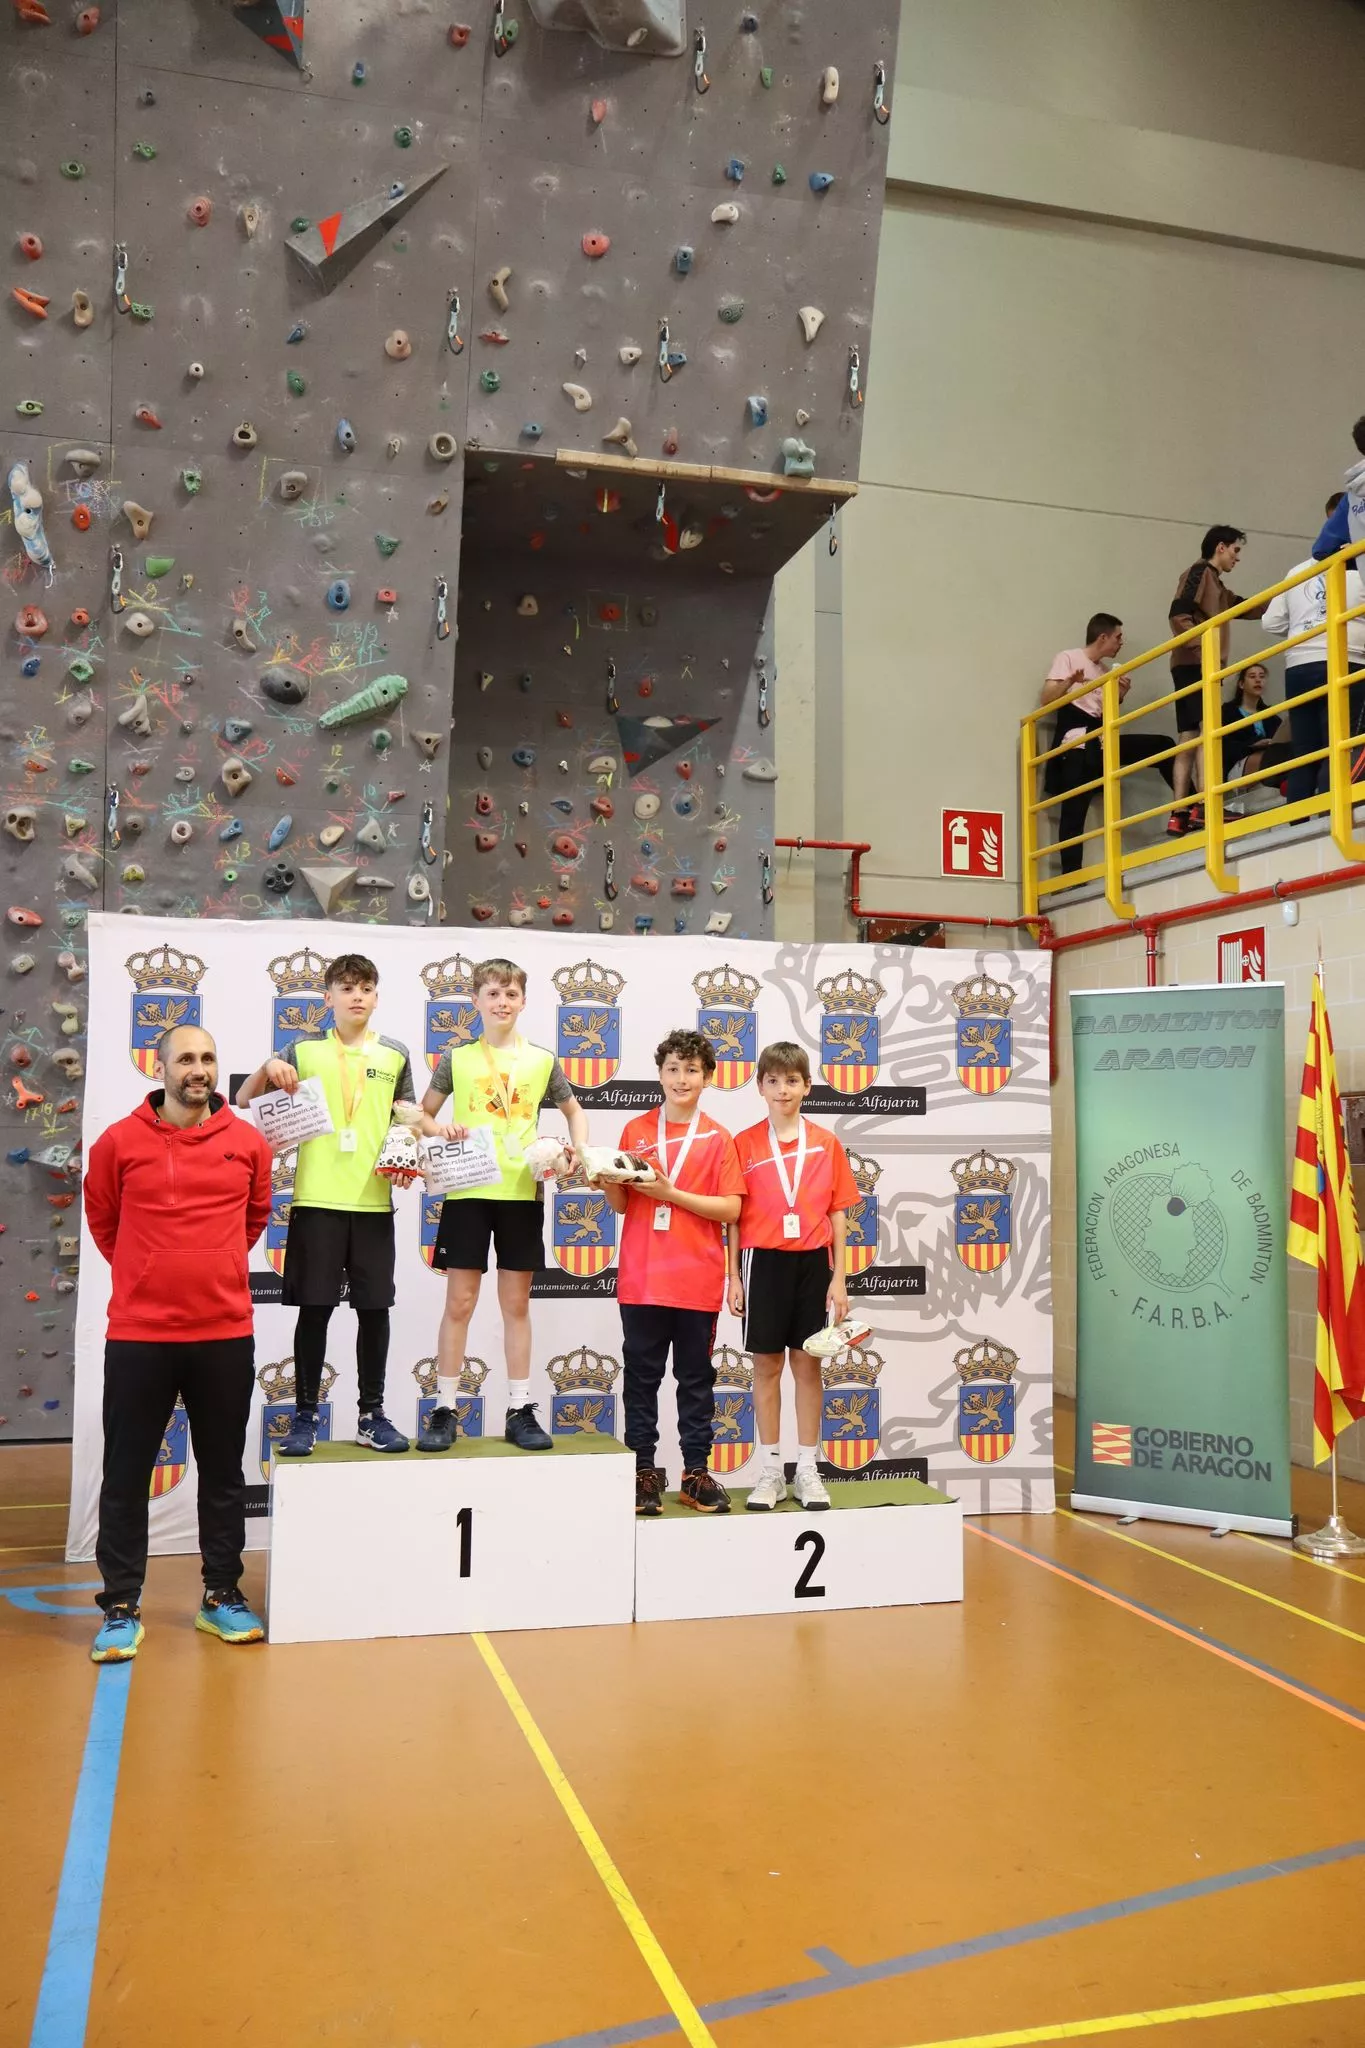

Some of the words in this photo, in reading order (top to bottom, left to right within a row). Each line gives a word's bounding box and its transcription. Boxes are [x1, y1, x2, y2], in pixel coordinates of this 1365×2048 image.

[1073, 1008, 1284, 1036] BADMINTON
[1093, 1045, 1256, 1071] ARAGON
[258, 1094, 303, 1120] RSL
[427, 1140, 474, 1161] RSL
[1084, 1191, 1107, 1281] FEDERACION
[1103, 1142, 1181, 1188] ARAGONESA
[1230, 1169, 1253, 1192] DE
[1246, 1192, 1273, 1285] BADMINTON
[581, 1282, 590, 1291] de
[1133, 1426, 1254, 1457] GOBIERNO
[1134, 1448, 1163, 1469] DE
[1171, 1452, 1272, 1482] ARAGON
[456, 1507, 473, 1578] 1
[794, 1529, 826, 1599] 2
